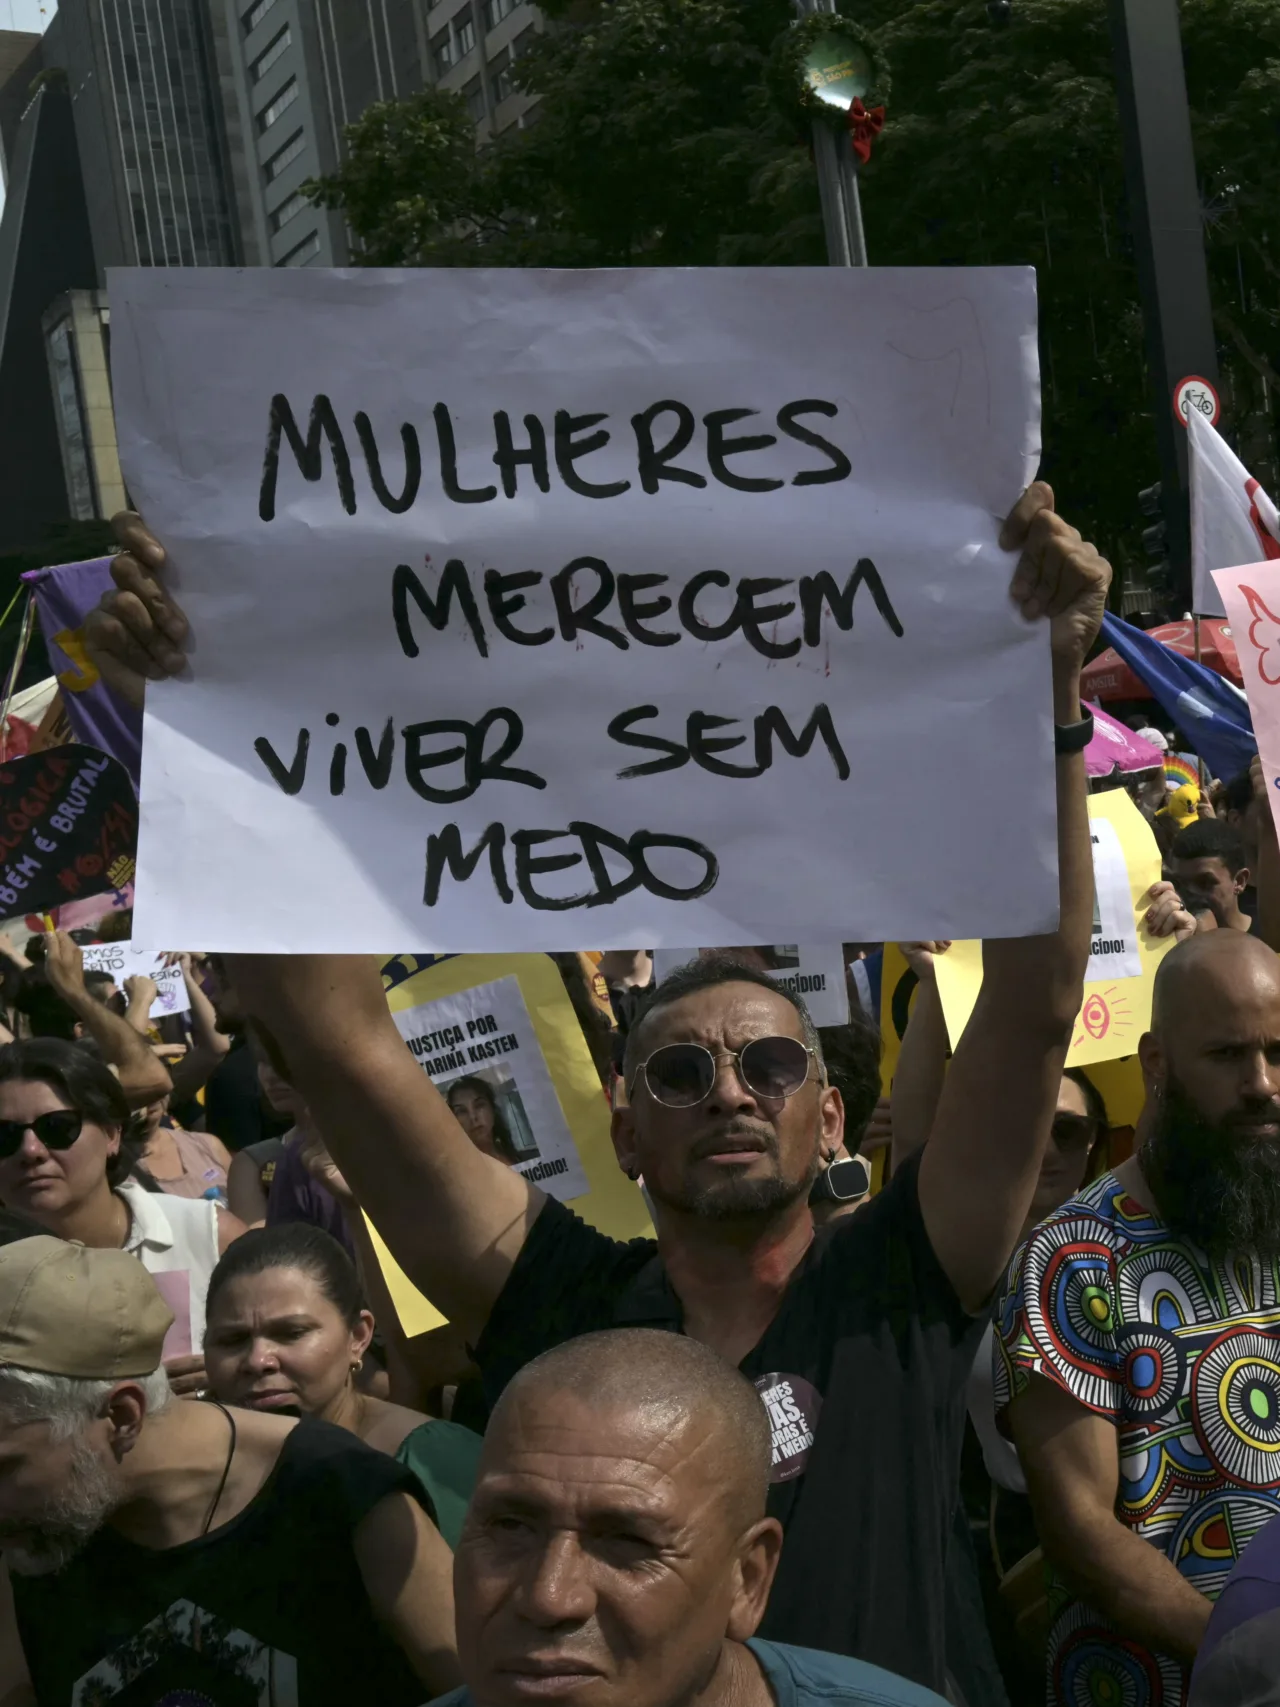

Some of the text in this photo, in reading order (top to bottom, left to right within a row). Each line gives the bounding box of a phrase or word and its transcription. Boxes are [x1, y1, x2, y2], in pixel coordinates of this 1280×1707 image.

[258, 393, 853, 522] MULHERES
[392, 556, 904, 659] MERECEM
[1085, 674, 1117, 693] AMSTEL
[607, 702, 851, 782] SEM
[49, 755, 110, 834] BRUTAL
[423, 821, 720, 911] MEDO
[466, 1014, 498, 1036] POR
[468, 1033, 519, 1063] KASTEN
[760, 1381, 793, 1406] ERES
[780, 1431, 814, 1459] MEDO
